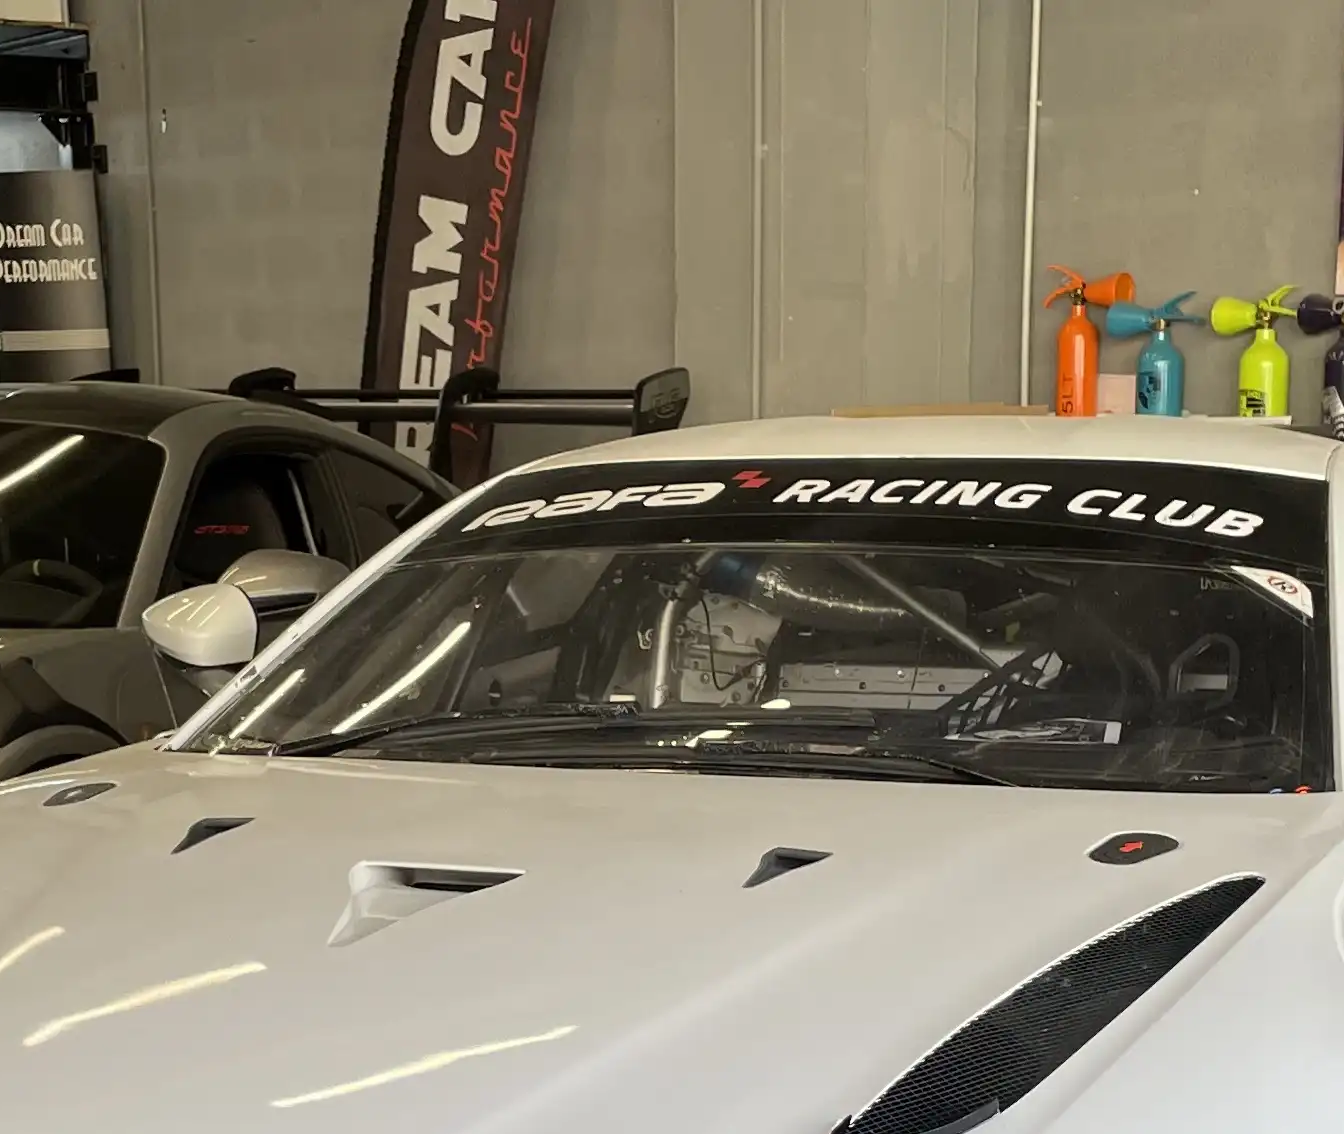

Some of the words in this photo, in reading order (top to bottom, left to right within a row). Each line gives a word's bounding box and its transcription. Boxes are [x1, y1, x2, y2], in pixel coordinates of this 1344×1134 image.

[49, 218, 84, 247] CAR
[394, 195, 468, 466] REAM
[772, 478, 1053, 510] RACING
[1066, 488, 1264, 538] CLUB
